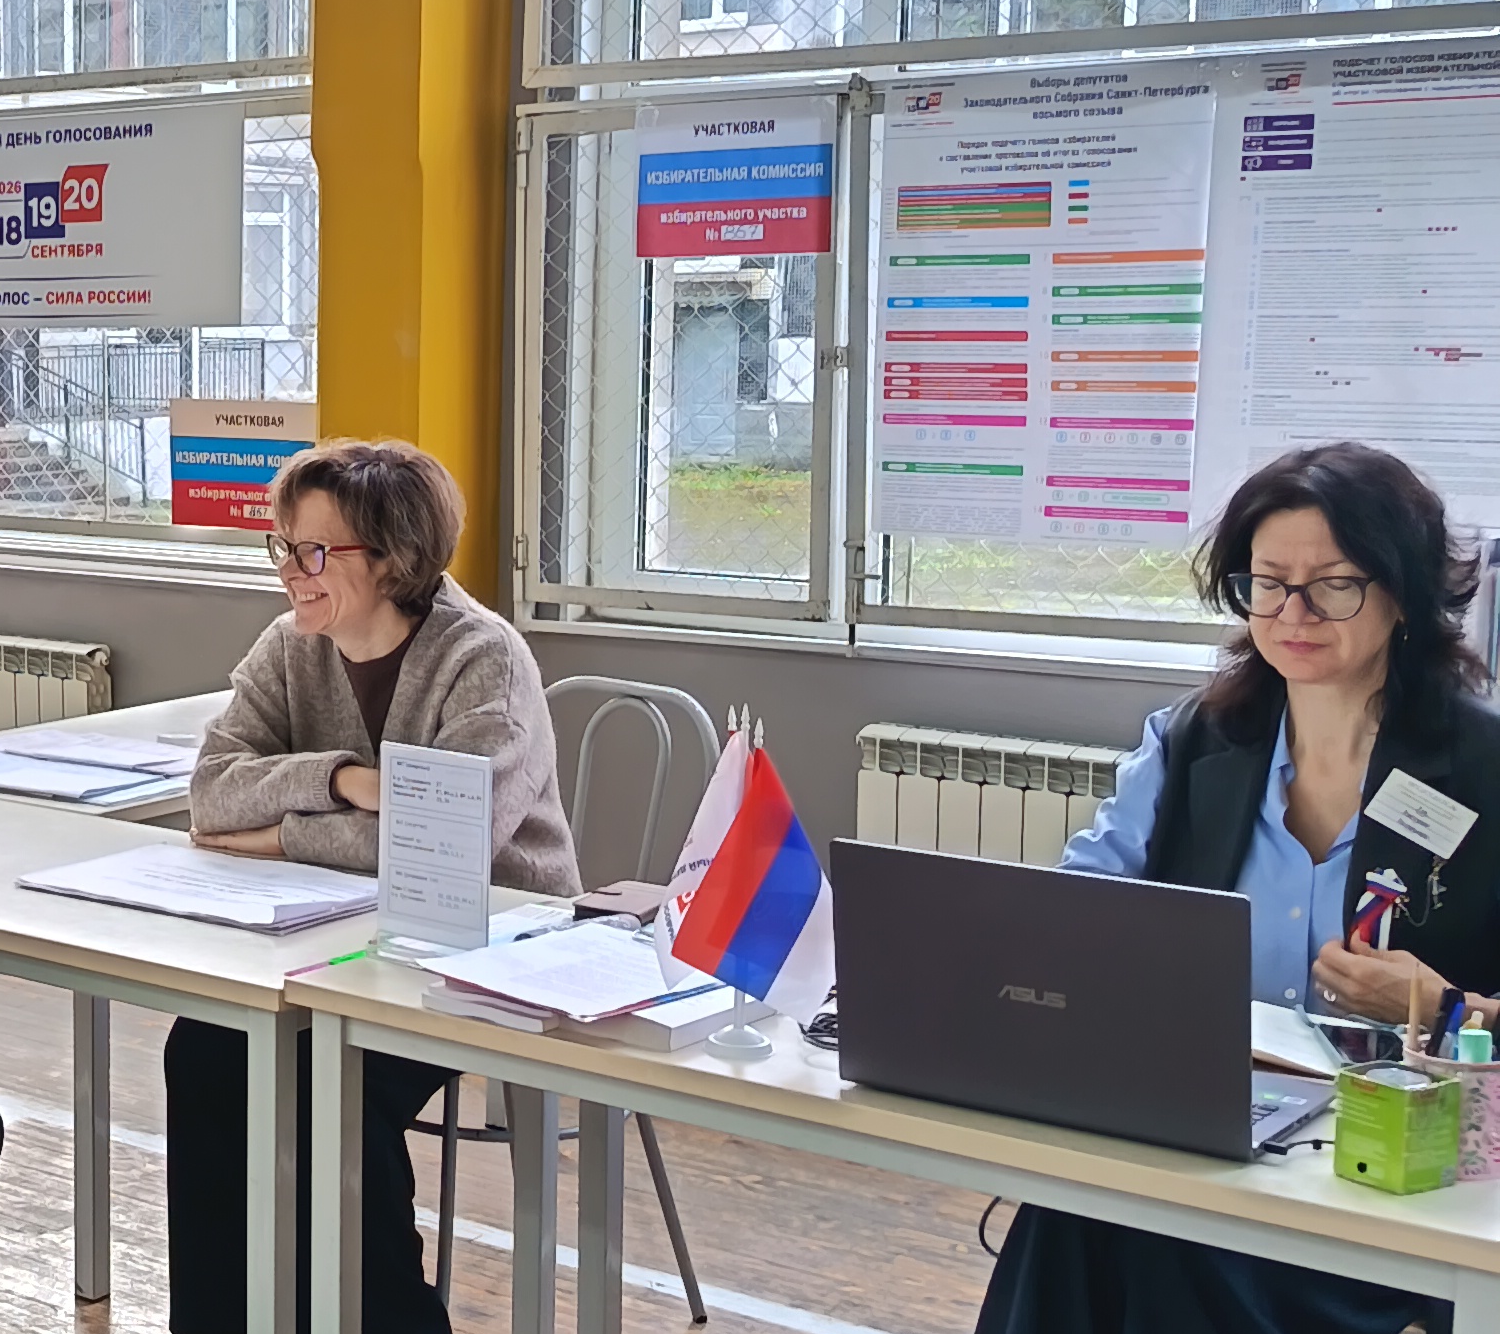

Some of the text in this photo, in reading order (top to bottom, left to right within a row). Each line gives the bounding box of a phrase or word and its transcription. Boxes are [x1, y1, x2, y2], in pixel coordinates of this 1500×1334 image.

[1030, 77, 1071, 89] Выборы
[1054, 91, 1104, 104] Собрания
[1107, 84, 1210, 101] Санкт-Петербурга
[5, 131, 42, 149] ДЕНЬ
[45, 123, 153, 144] ГОЛОСОВАНИЯ
[693, 120, 775, 137] УЧАСТКОВАЯ
[646, 162, 824, 185] ИЗБИРАТЕЛЬНАЯ КОМИССИЯ
[63, 178, 99, 210] 20
[27, 196, 57, 227] 19
[660, 206, 807, 225] избирательного участка
[31, 243, 104, 259] СЕНТЯБРЯ
[46, 290, 84, 306] СИЛА
[88, 289, 152, 305] РОССИИ!
[215, 413, 284, 427] УЧАСТКОВАЯ
[175, 451, 265, 466] ИЗБИРАТЕЛЬНАЯ
[997, 984, 1067, 1010] ASUS
